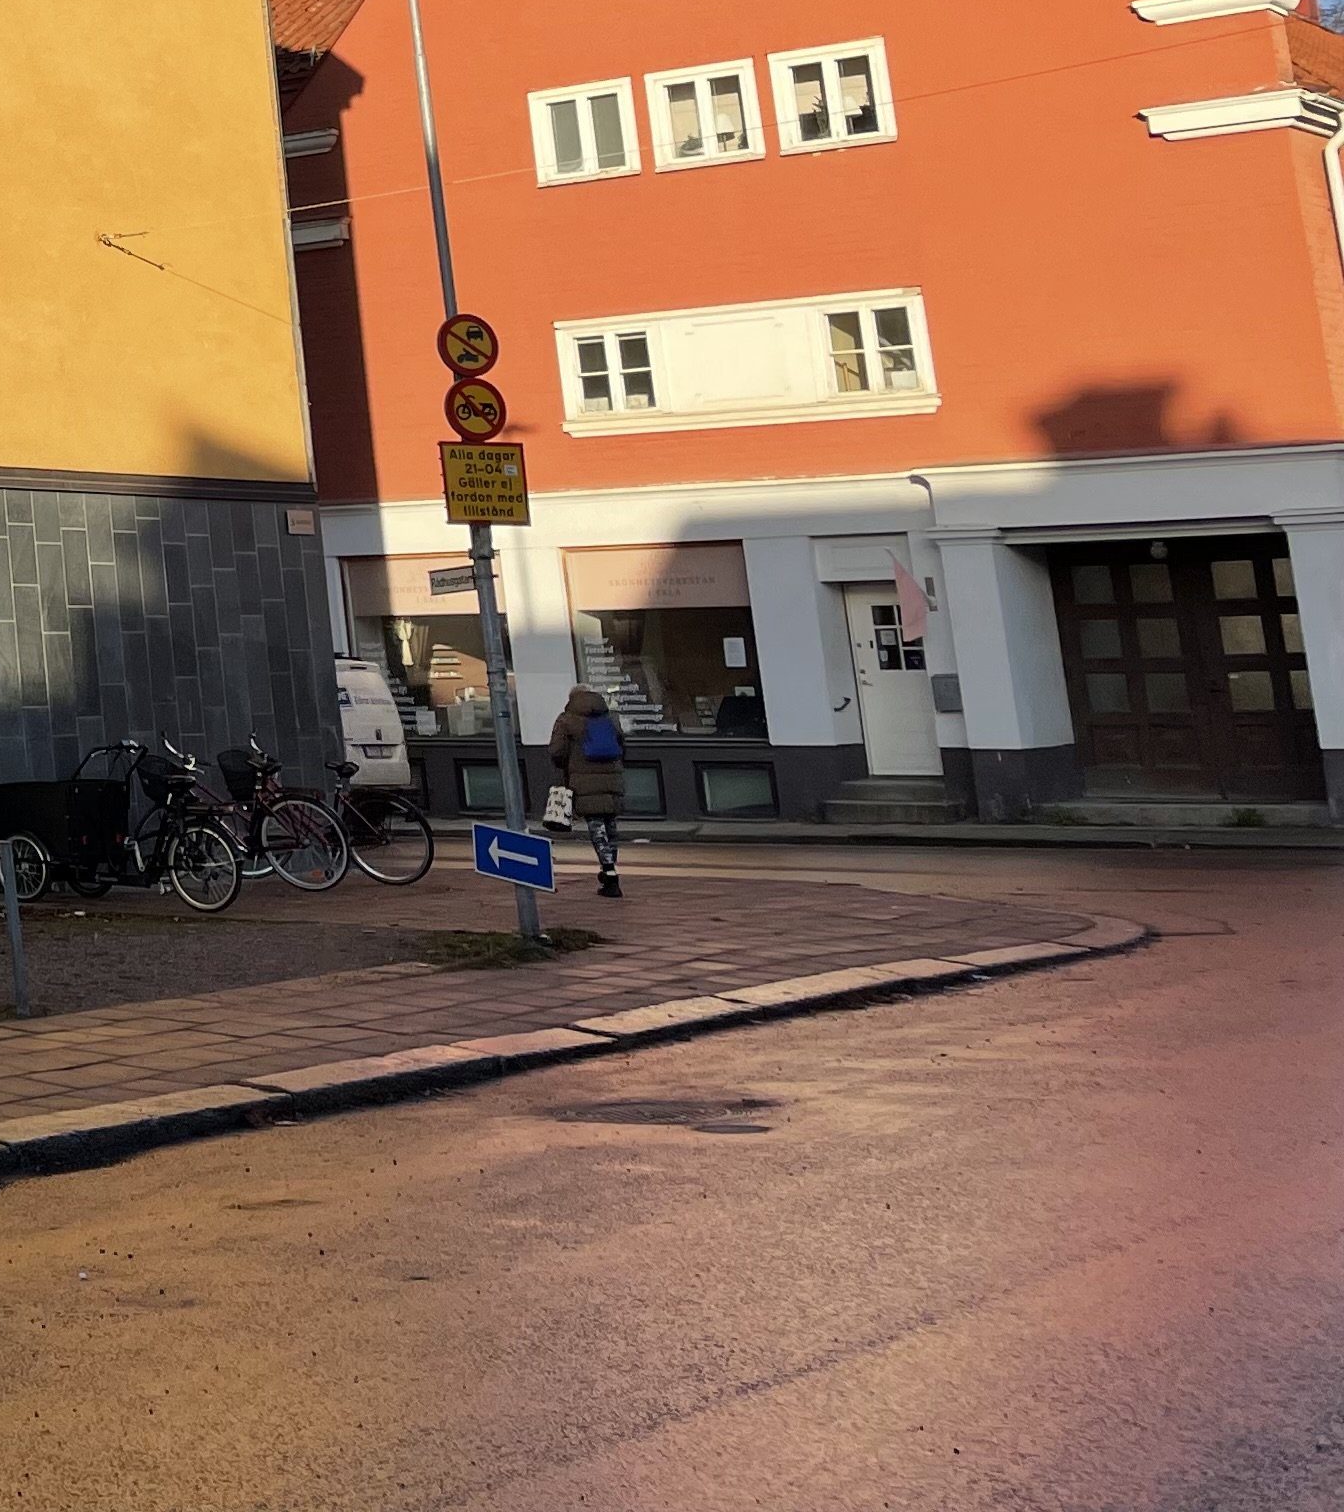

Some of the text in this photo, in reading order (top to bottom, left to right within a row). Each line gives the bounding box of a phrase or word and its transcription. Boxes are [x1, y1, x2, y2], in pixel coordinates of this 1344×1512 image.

[450, 449, 515, 463] Alla dagar
[458, 477, 496, 489] Gäller
[451, 491, 523, 503] fordon med
